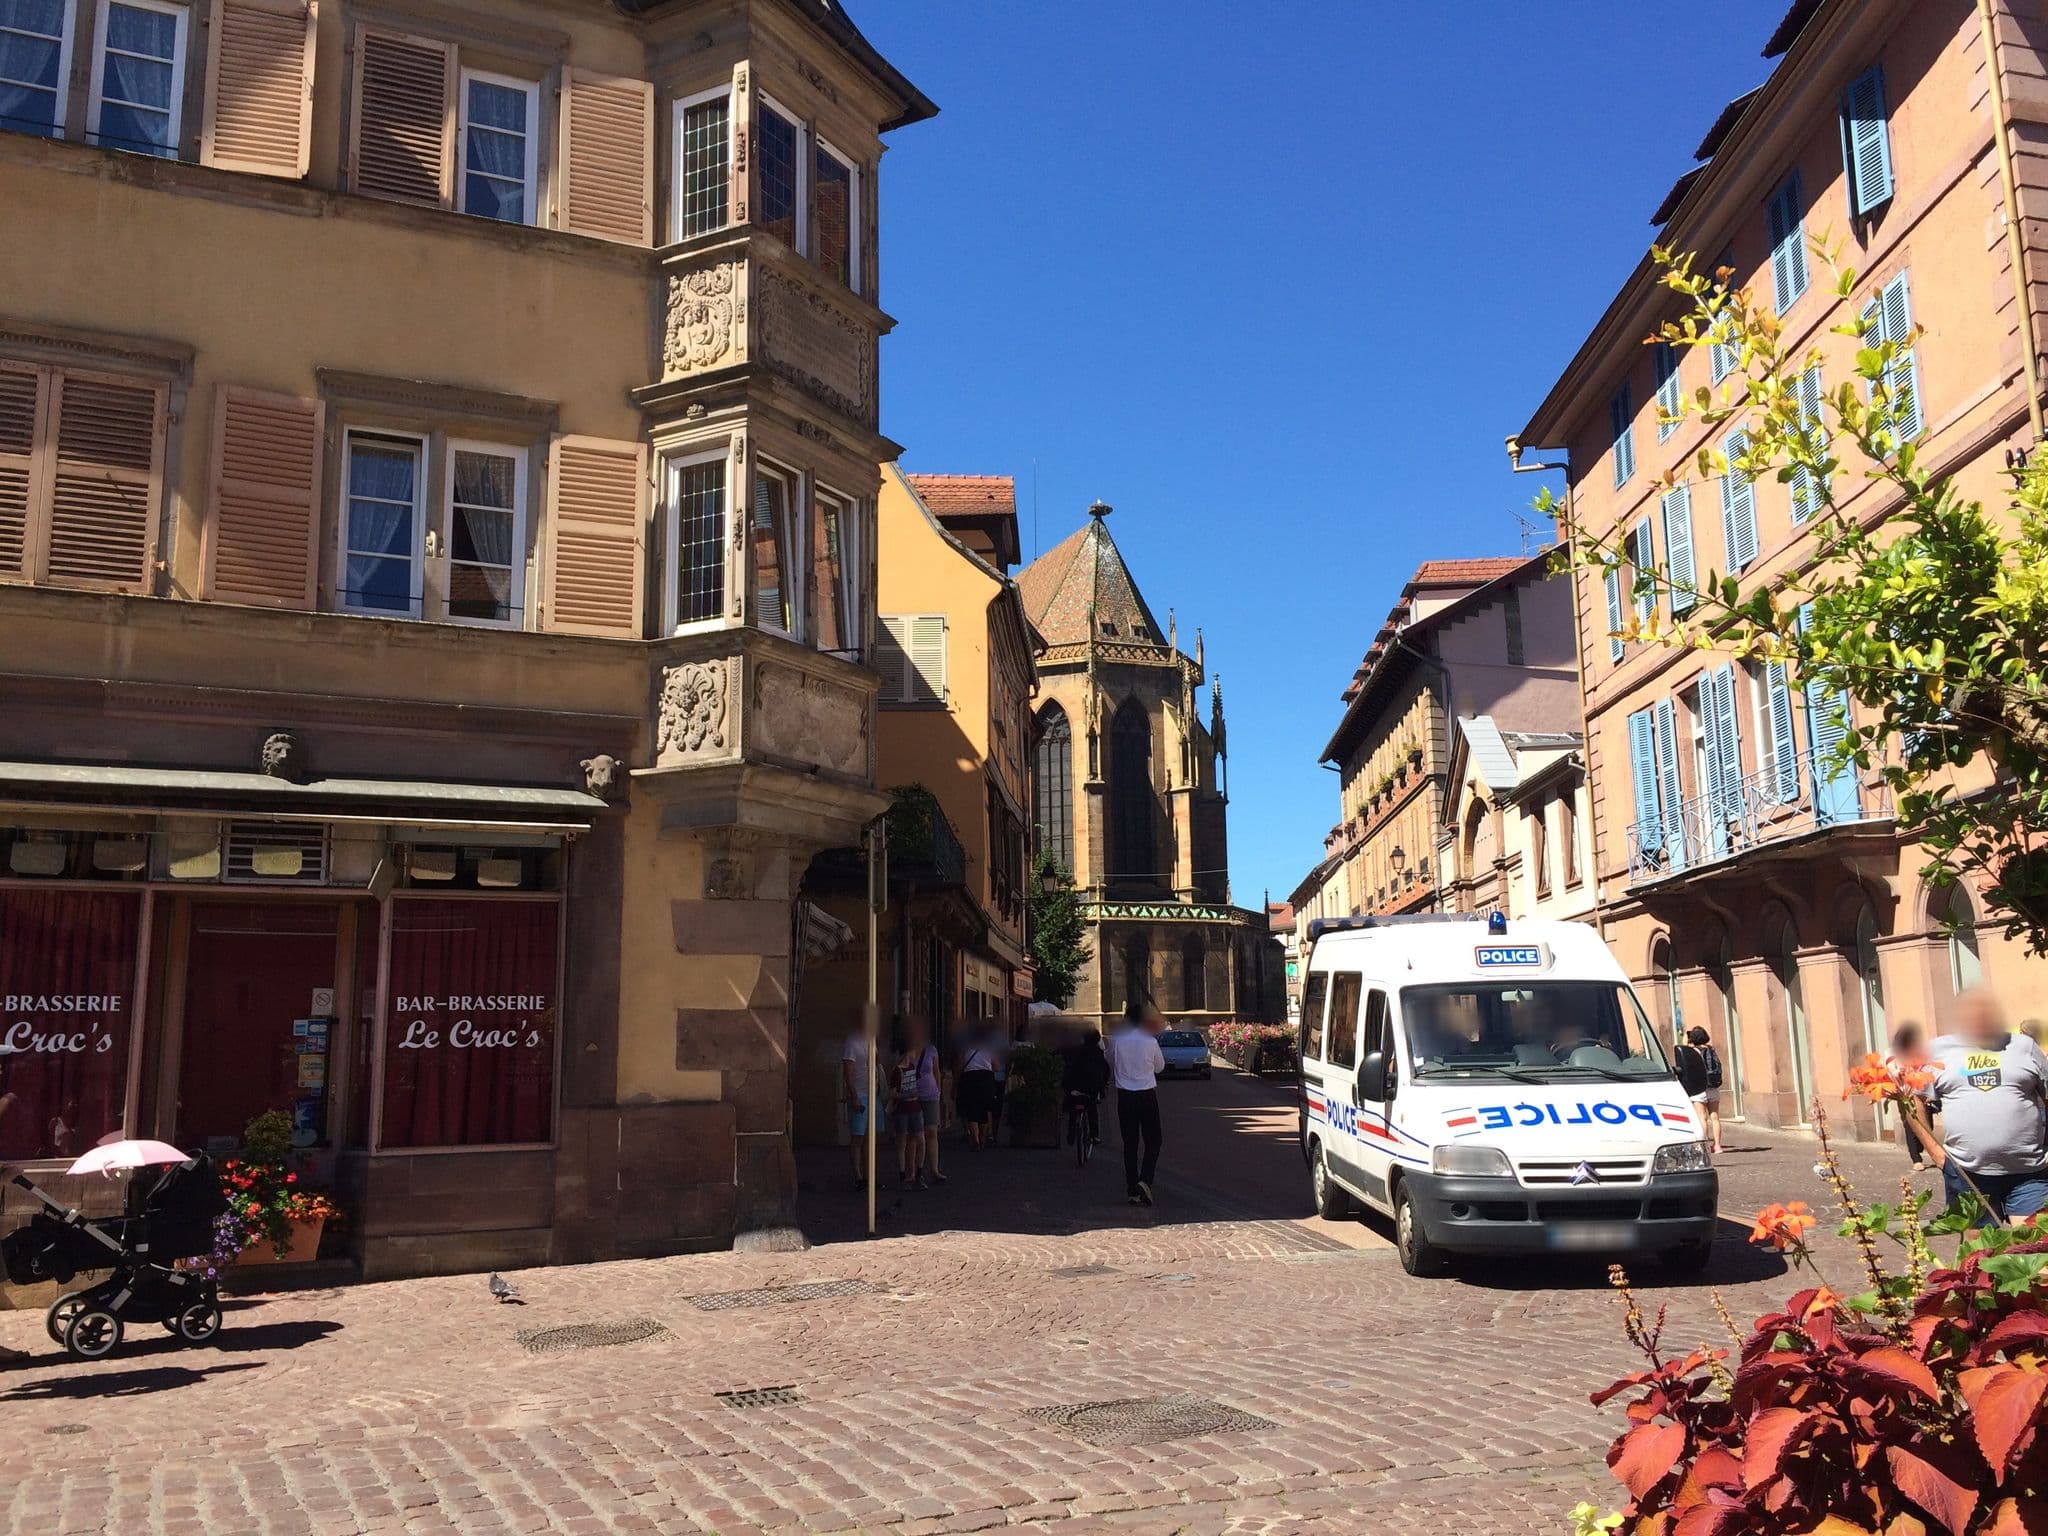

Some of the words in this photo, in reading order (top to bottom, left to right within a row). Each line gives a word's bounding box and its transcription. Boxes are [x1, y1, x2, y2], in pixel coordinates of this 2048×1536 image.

[1480, 950, 1537, 963] POLICE
[0, 995, 121, 1012] BRASSERIE
[396, 995, 545, 1012] BAR-BRASSERIE
[5, 1021, 113, 1053] Croc's
[398, 1019, 440, 1049] Le
[449, 1019, 540, 1049] Croc's
[1967, 1055, 1998, 1070] Nike
[1972, 1075, 1997, 1086] 1972
[1327, 1098, 1358, 1137] POLICE
